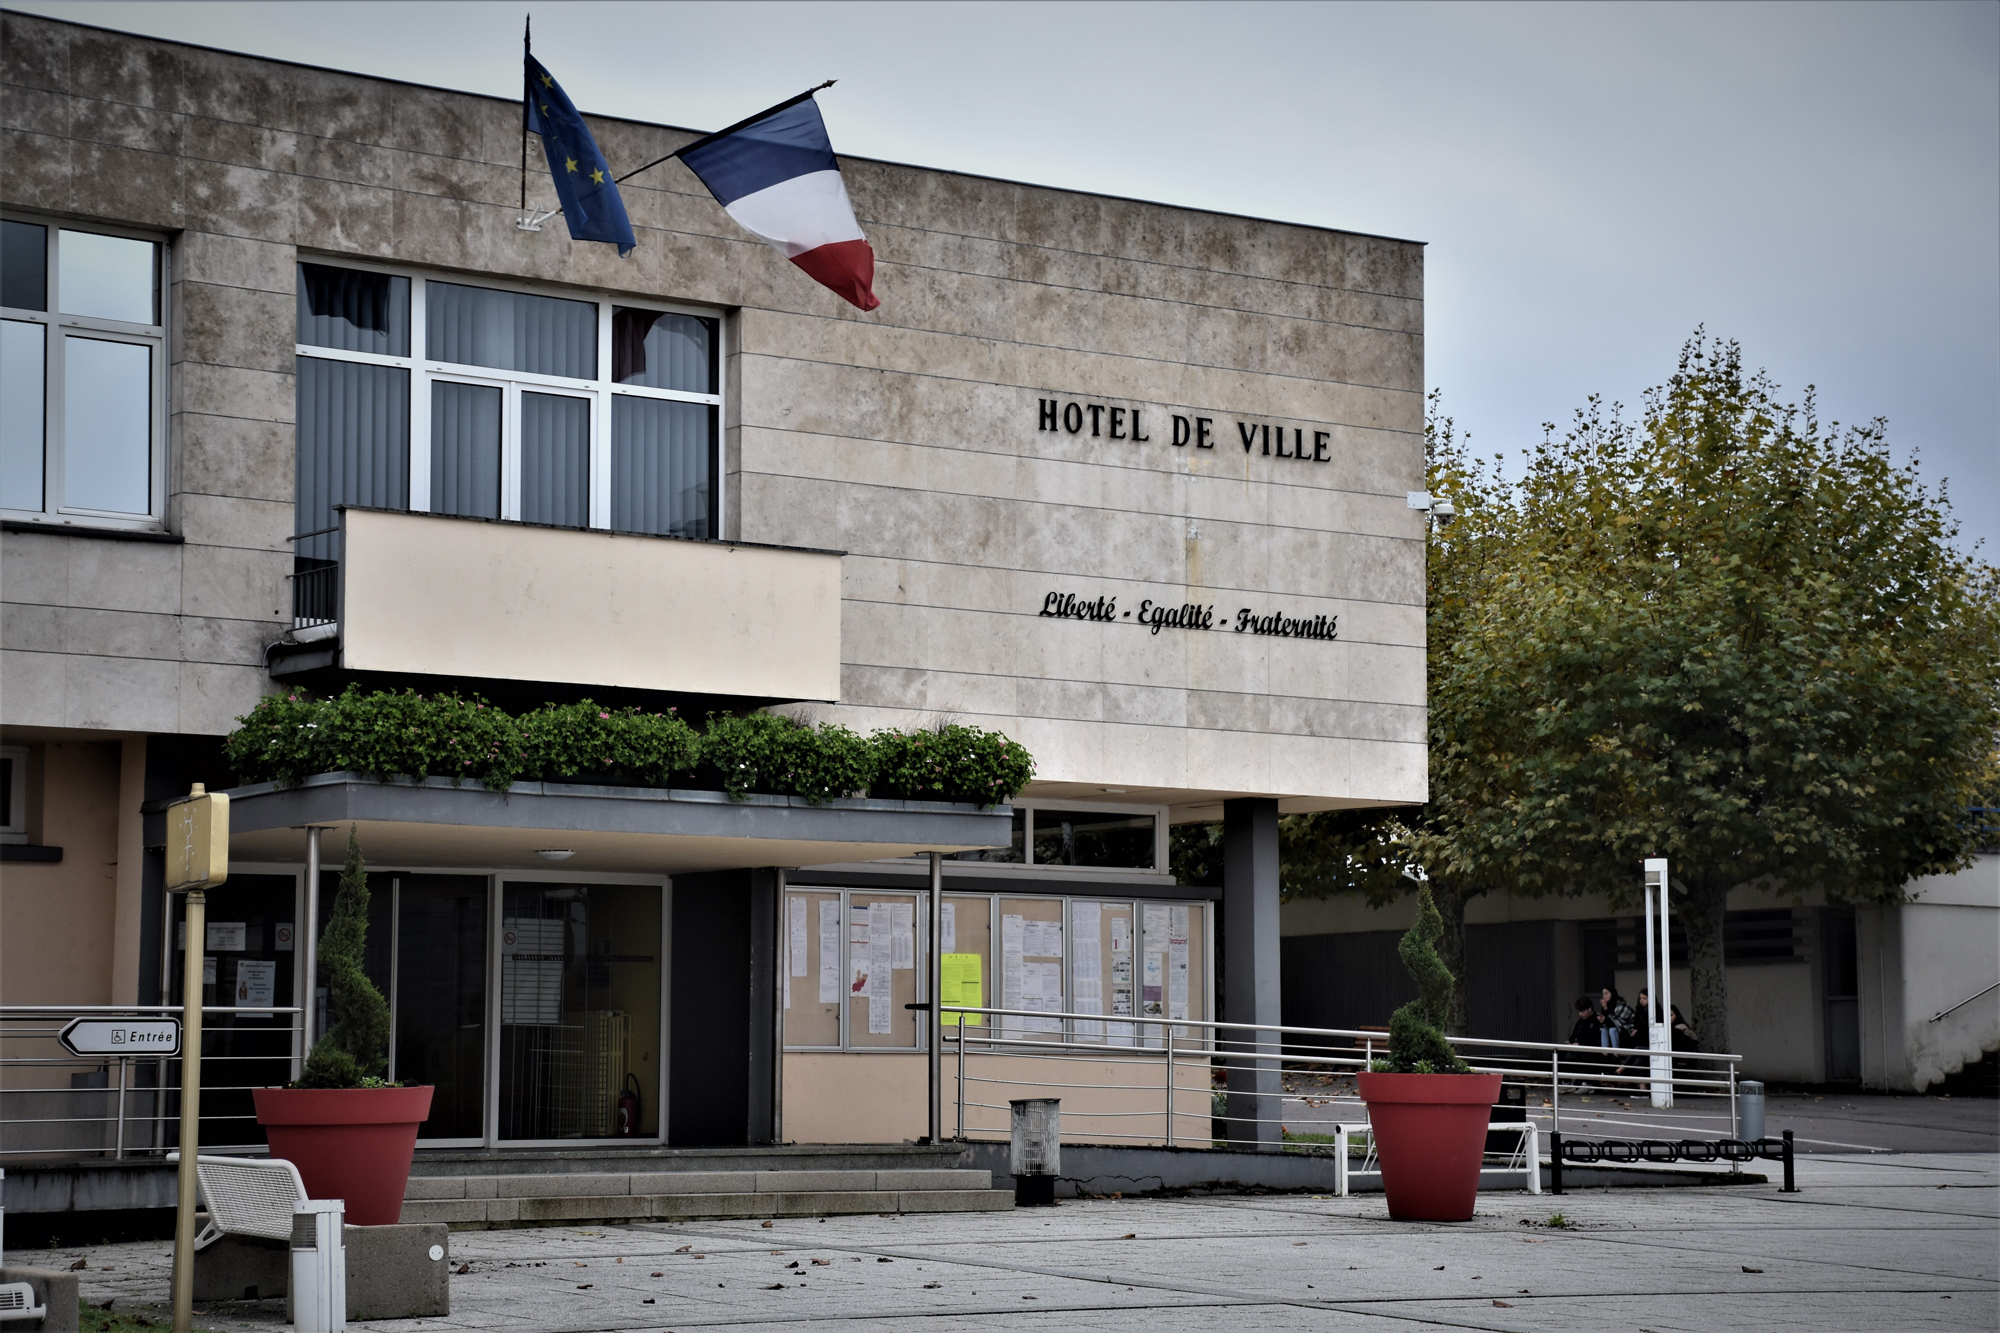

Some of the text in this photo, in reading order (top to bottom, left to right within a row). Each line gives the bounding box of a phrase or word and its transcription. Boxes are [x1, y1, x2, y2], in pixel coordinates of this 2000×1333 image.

[1038, 398, 1332, 463] HOTEL DE VILLE
[1039, 591, 1116, 622] Liberté
[1137, 599, 1214, 636] Egalité
[1235, 608, 1338, 640] Fraternité
[129, 1031, 172, 1042] Entrée
